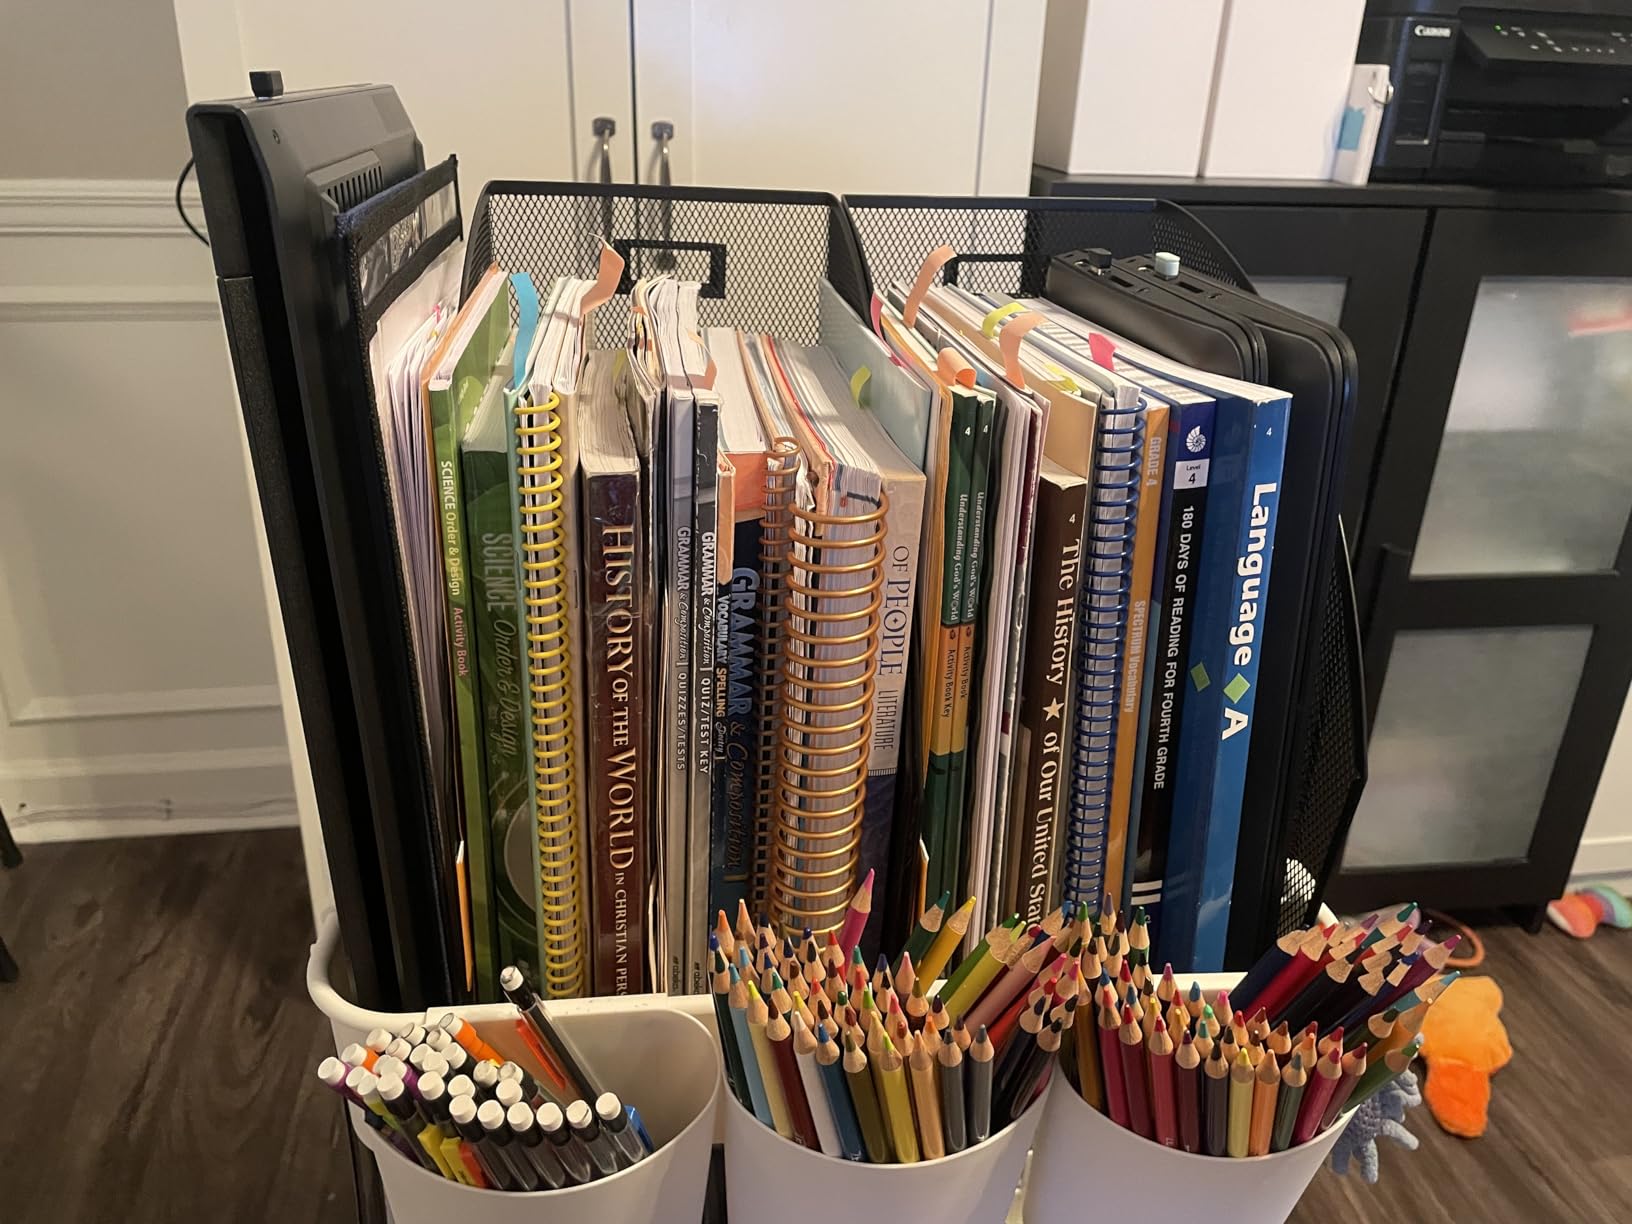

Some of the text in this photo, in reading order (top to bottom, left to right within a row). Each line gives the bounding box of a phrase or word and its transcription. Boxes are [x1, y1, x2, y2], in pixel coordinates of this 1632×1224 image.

[964, 426, 971, 436] 4
[983, 424, 988, 434] 4
[1147, 437, 1161, 475] GRADE
[1266, 428, 1272, 437] 4
[1188, 473, 1196, 485] 4
[441, 461, 462, 596] SCIENCE Order & Design
[967, 491, 985, 618] Understanding God's World
[1069, 514, 1076, 524] 4
[950, 493, 968, 621] Understanding God's World
[1059, 538, 1080, 590] The
[602, 525, 635, 678] HISTORY
[878, 546, 911, 676] OF PEOPLE
[1221, 482, 1277, 741] Language A
[452, 608, 469, 677] Activity Book
[481, 532, 521, 758] SCIENCE Order & Design
[674, 527, 692, 771] GRAMMAR & Composition QUIZZES/TESTS
[697, 532, 715, 774] GRAMMAR & Composition QUIZ/TEST KEY
[716, 594, 731, 754] VOCABULARY SPELLING Poetry
[960, 646, 971, 699] Activity Book
[1046, 597, 1074, 685] History
[1123, 600, 1146, 713] SPECTRUM Vocabulary
[1154, 505, 1195, 790] 180 DAYS OF READING FOR FOURTH GRADE
[612, 678, 629, 702] OF
[727, 567, 760, 869] GRAMMAR & Composition
[874, 689, 899, 750] LITERATURE
[941, 649, 956, 718] Activity Book Key
[612, 707, 629, 747] THE
[1043, 732, 1061, 755] of
[607, 747, 637, 869] WORLD
[1039, 761, 1057, 801] Our
[615, 872, 625, 886] IN
[1032, 807, 1053, 879] United
[613, 889, 628, 963] CHRISTIAN
